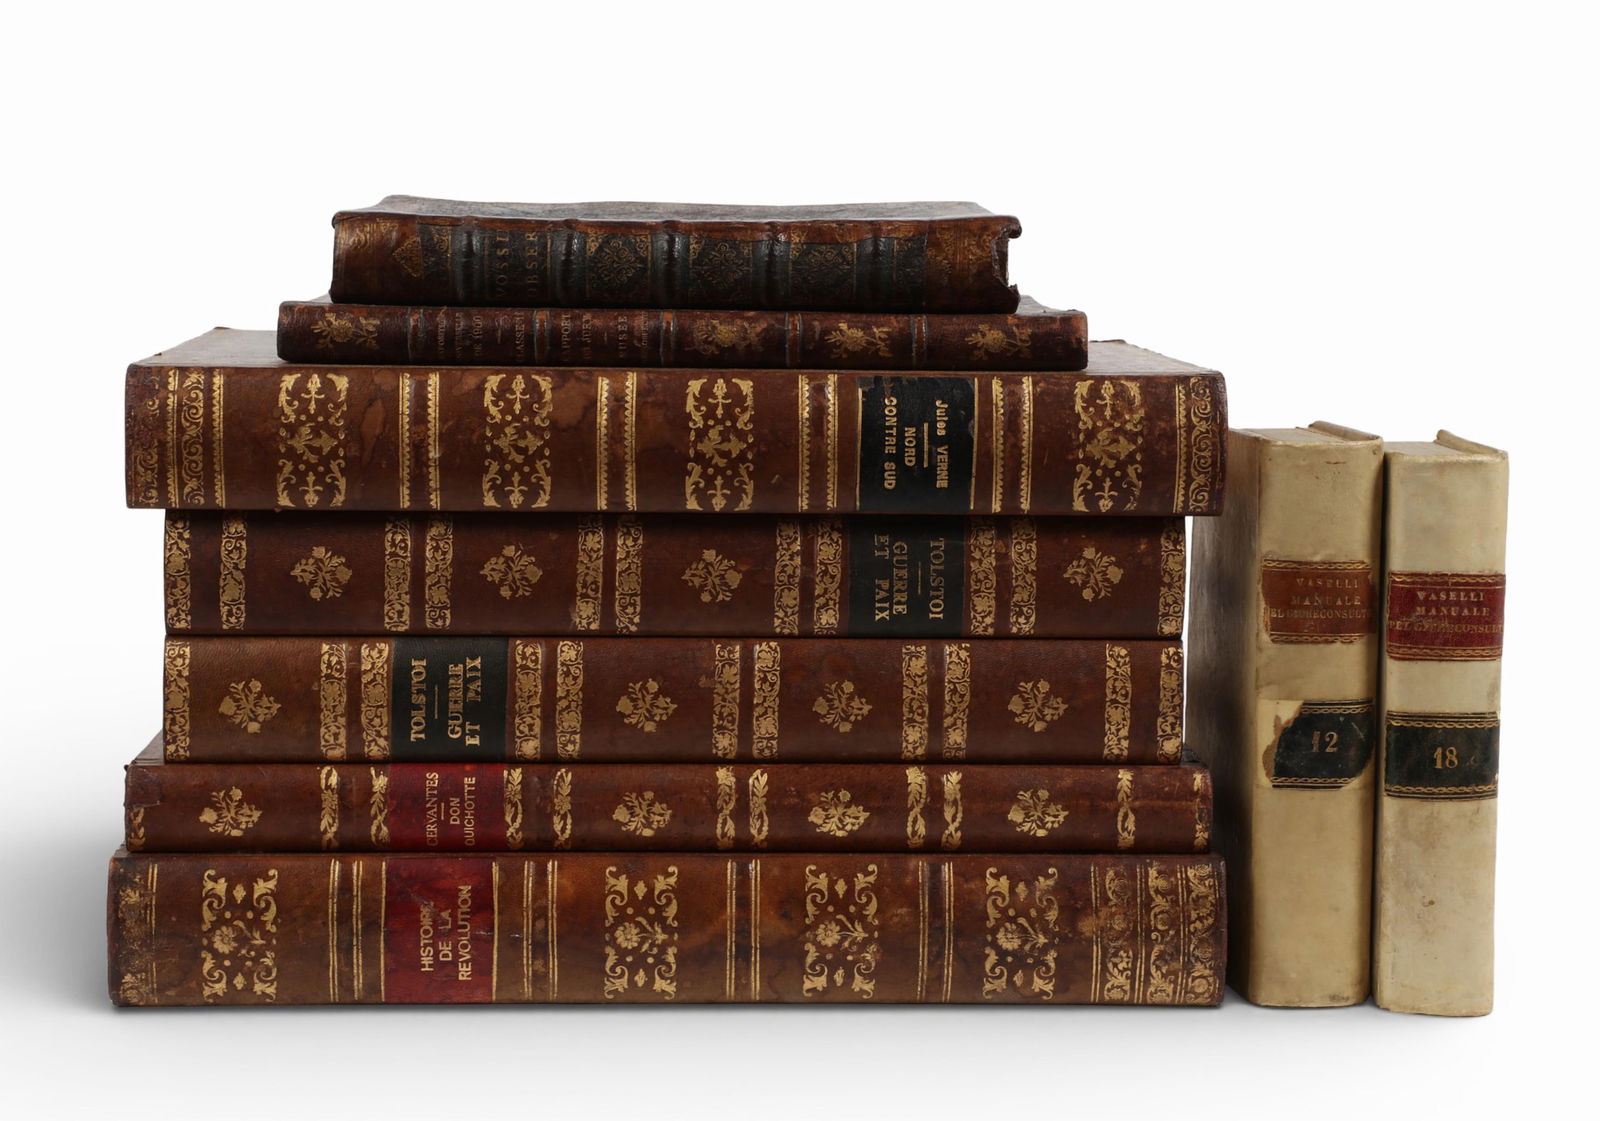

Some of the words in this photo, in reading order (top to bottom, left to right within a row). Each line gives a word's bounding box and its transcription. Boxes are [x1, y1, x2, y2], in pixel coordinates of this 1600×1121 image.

[884, 396, 898, 454] CONTRE
[935, 399, 949, 436] Jules
[904, 427, 917, 467] NORD
[884, 461, 898, 490] SUD
[935, 445, 949, 489] VERNE
[874, 533, 890, 560] ET
[892, 541, 908, 615] GUERRE
[929, 537, 945, 620] TOLSTOI
[1416, 591, 1485, 601] VASELLI
[874, 578, 890, 622] PAIX
[1268, 607, 1285, 619] EL
[1415, 606, 1491, 616] MANUALE
[465, 656, 481, 702] PAIX
[410, 658, 427, 742] TOLSTOI
[447, 663, 464, 739] GUERRE
[465, 721, 481, 747] ET
[1310, 730, 1340, 753] 12
[1433, 746, 1460, 770] 18
[425, 772, 439, 847] CERVANTES
[449, 797, 461, 825] DON
[463, 776, 477, 847] QUICHOTTE
[438, 908, 452, 930] LA
[457, 885, 472, 981] REVOLUTION
[438, 940, 453, 961] DE
